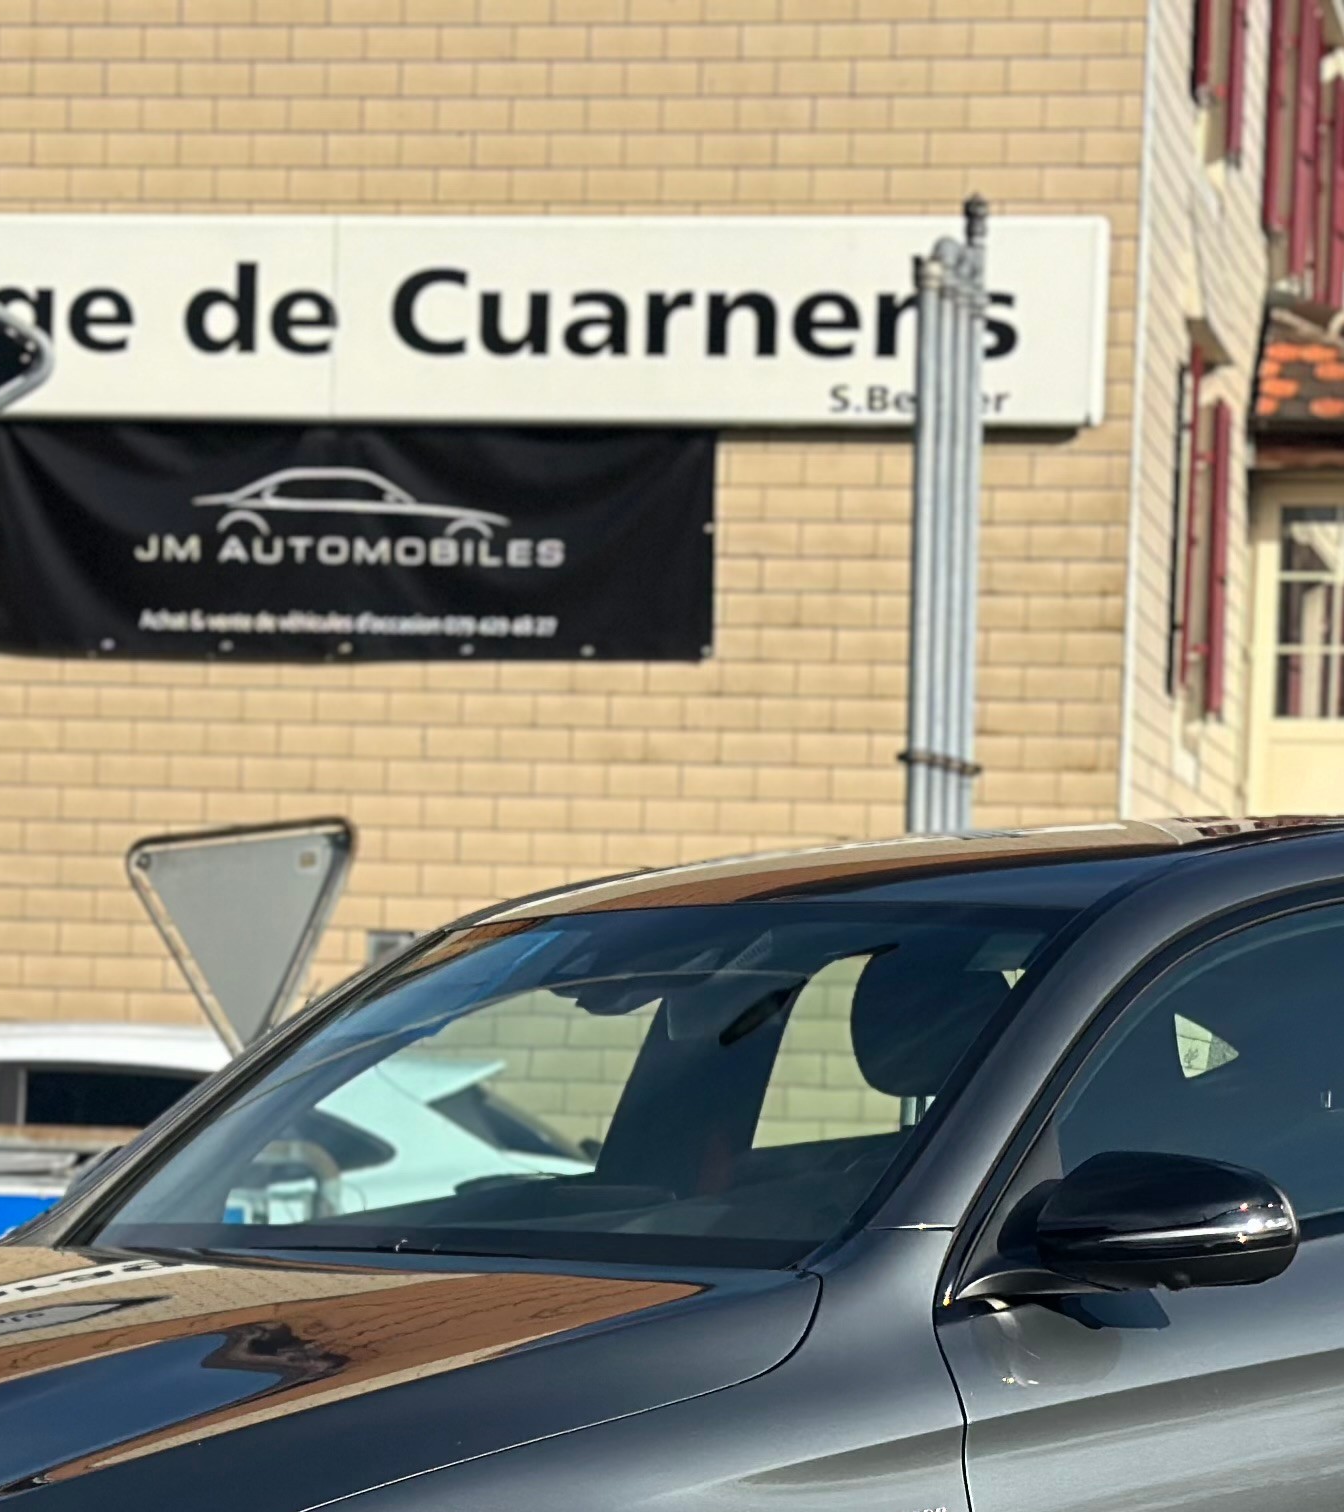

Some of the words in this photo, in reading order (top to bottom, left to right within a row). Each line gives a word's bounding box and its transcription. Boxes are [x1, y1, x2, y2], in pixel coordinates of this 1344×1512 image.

[184, 260, 338, 355] de
[134, 534, 202, 562] JM
[217, 534, 566, 568] AUTOMOBILES
